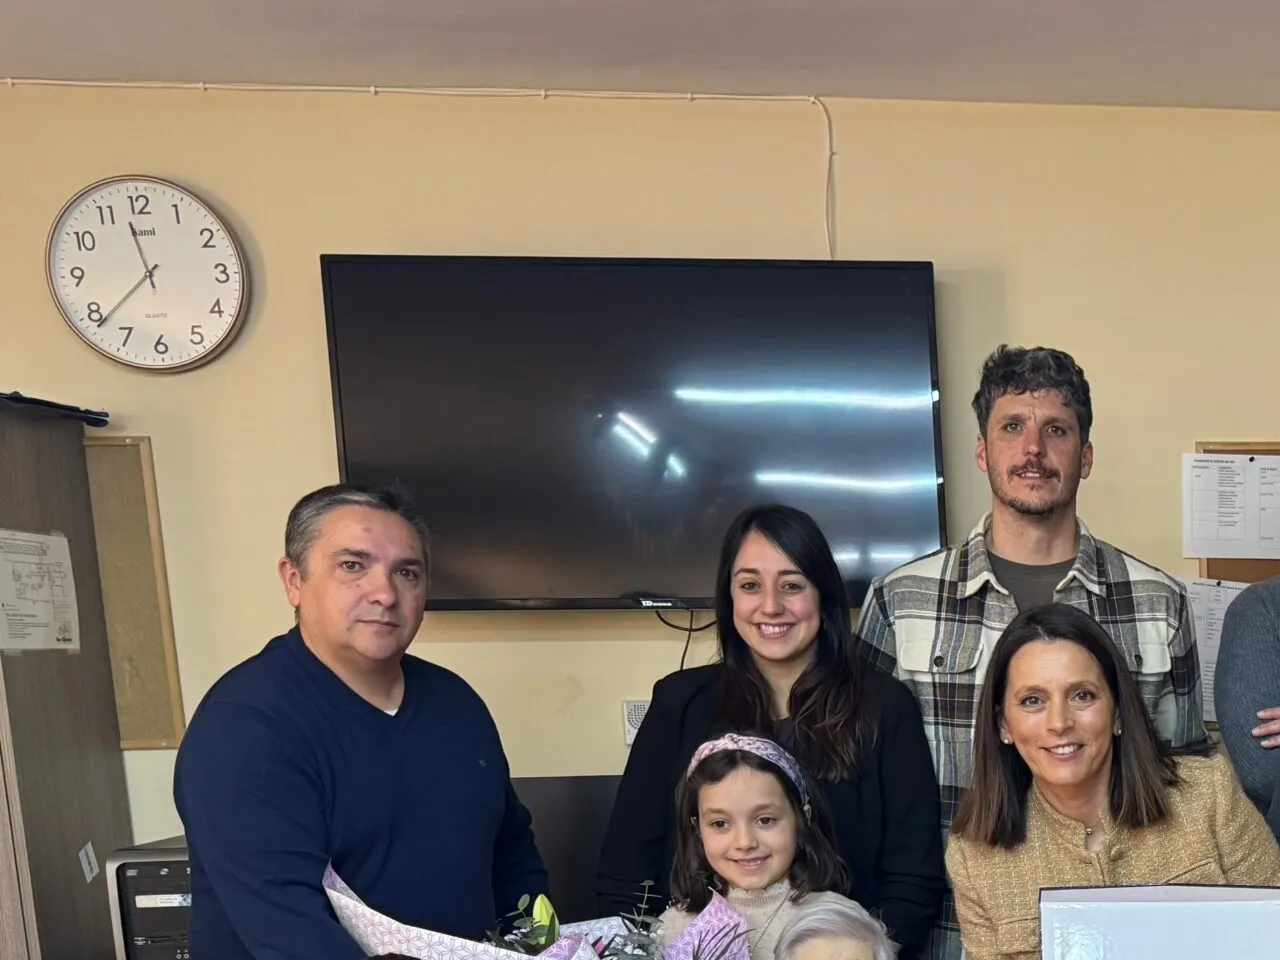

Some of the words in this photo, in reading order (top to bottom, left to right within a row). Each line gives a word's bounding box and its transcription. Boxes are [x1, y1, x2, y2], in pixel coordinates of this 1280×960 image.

[96, 205, 116, 225] 11
[127, 194, 152, 216] 12
[171, 203, 181, 225] 1
[73, 230, 96, 252] 10
[200, 227, 217, 249] 2
[69, 266, 86, 288] 9
[213, 263, 231, 284] 3
[86, 301, 104, 323] 8
[208, 297, 225, 319] 4
[118, 326, 134, 348] 7
[153, 334, 169, 355] 6
[189, 325, 205, 346] 5
